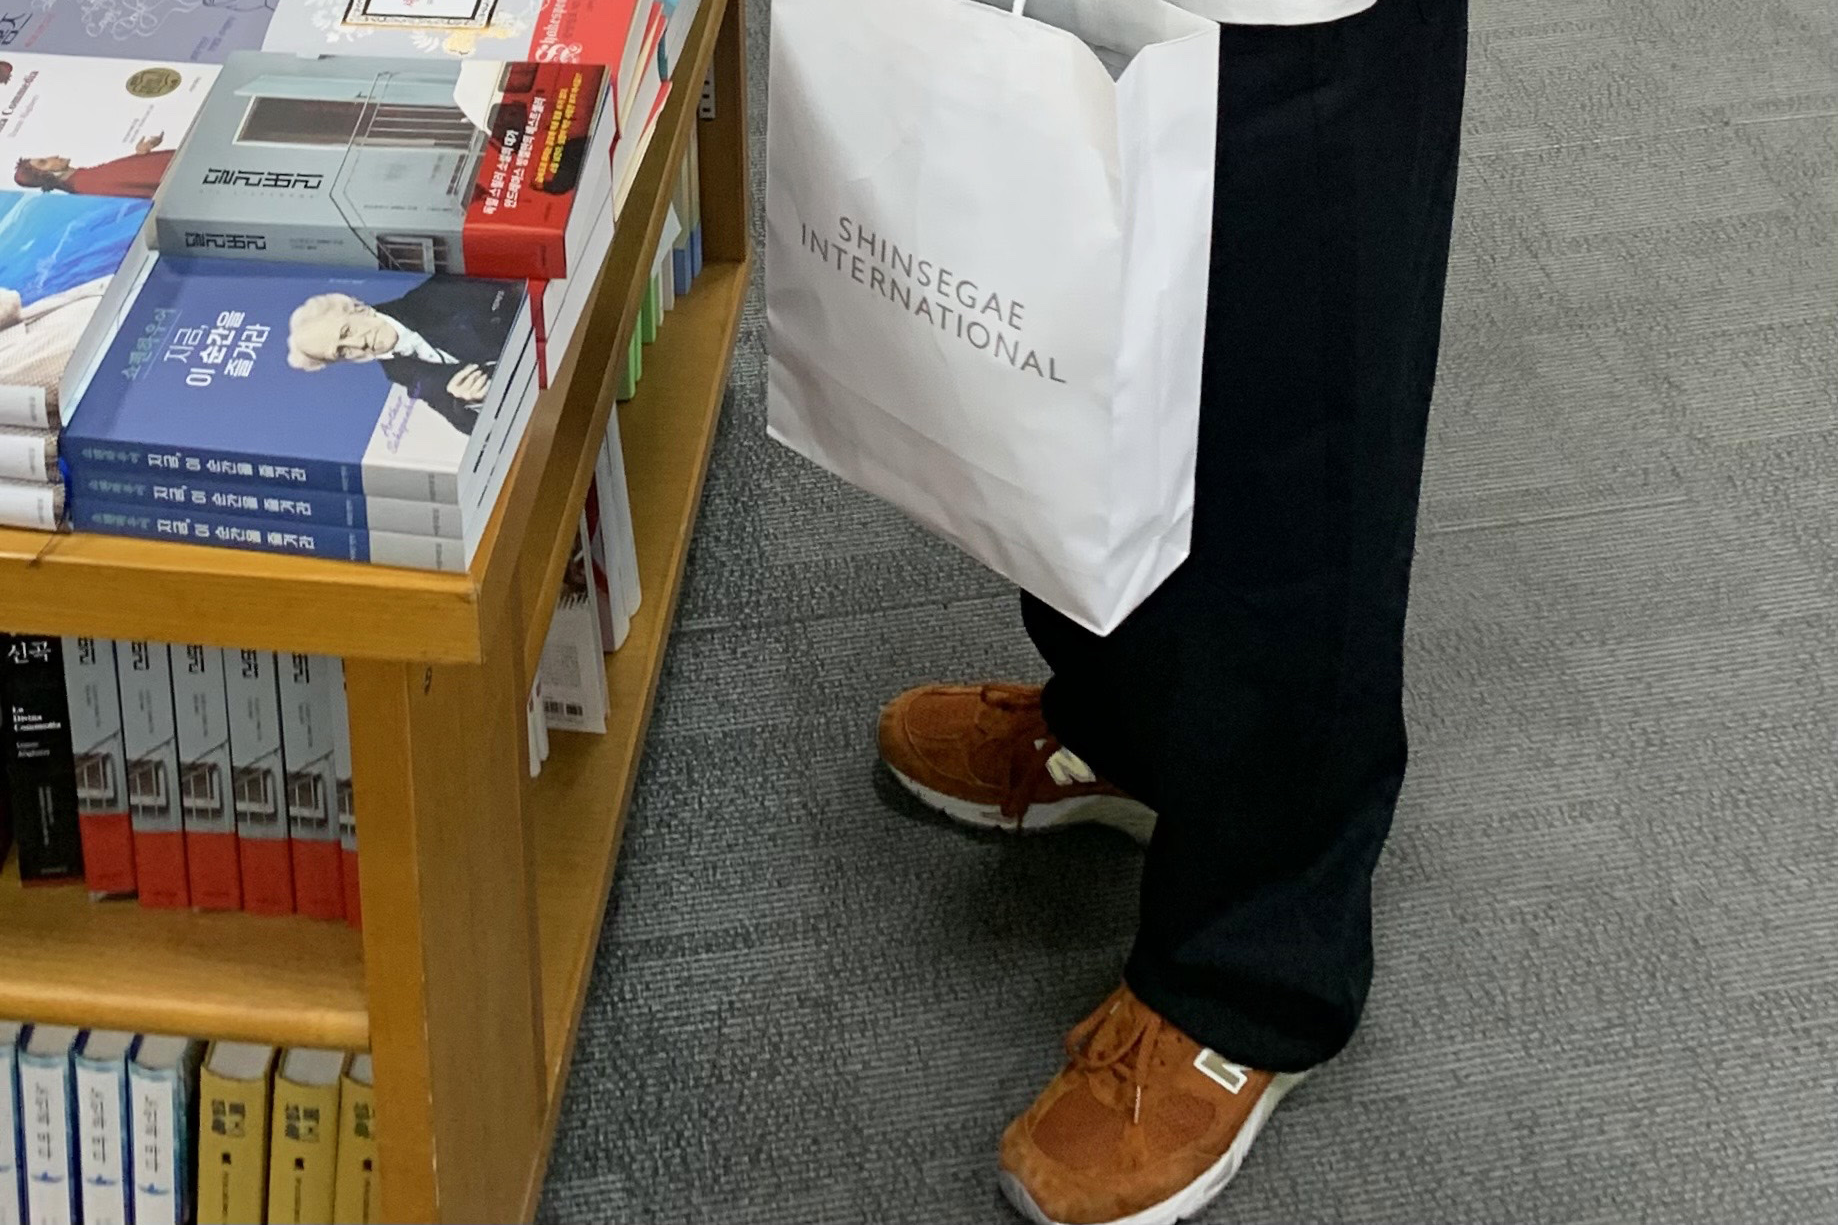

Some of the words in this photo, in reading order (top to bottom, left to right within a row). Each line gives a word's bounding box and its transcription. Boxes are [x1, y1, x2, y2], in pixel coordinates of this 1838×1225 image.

[201, 167, 325, 189] 딜리버리
[838, 216, 1025, 331] SHINSEGAE
[801, 223, 1067, 384] INTERNATIONAL
[164, 326, 208, 364] 지금,
[199, 311, 247, 364] 순간을
[224, 324, 272, 378] 즐겨라
[185, 368, 216, 387] 이
[8, 641, 52, 664] 신곡
